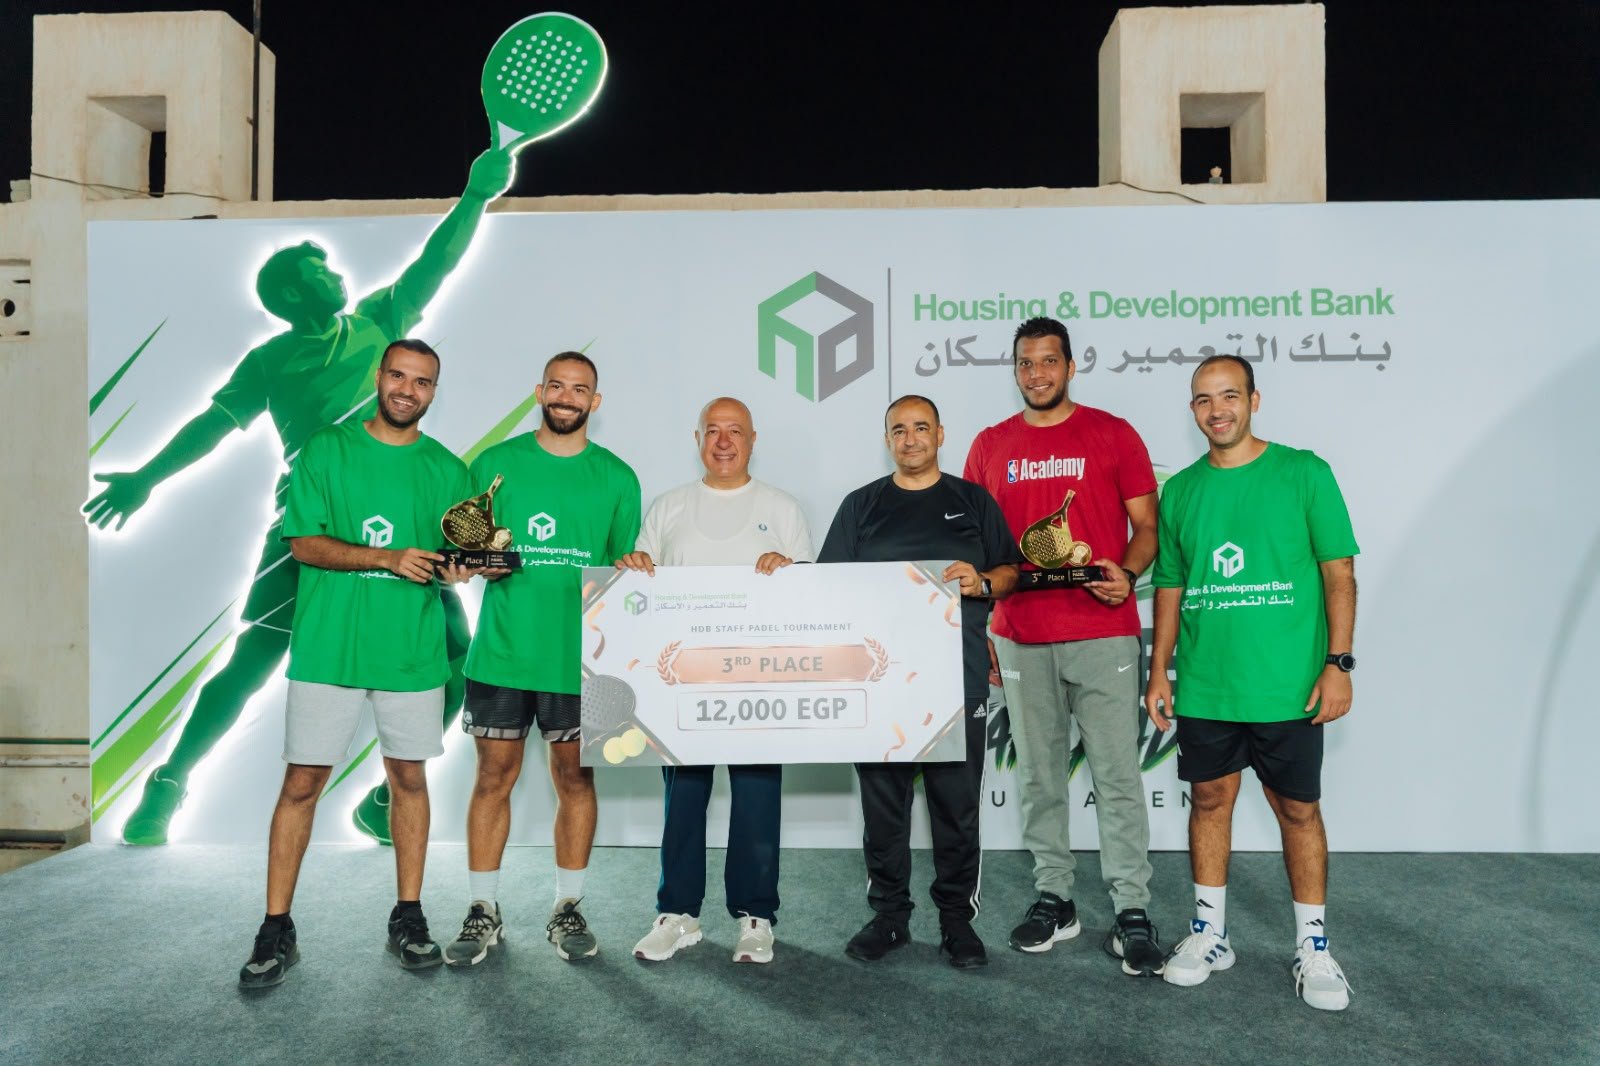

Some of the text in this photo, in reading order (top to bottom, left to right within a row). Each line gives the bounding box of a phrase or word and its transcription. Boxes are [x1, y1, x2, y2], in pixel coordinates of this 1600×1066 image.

[914, 287, 1395, 325] Housing & Development Bank
[1020, 455, 1086, 480] Academy
[465, 557, 483, 565] Place
[1202, 585, 1209, 594] &
[1210, 582, 1271, 594] Development
[691, 623, 852, 633] HDB STAFF PADEL TOURNAMENT
[722, 656, 823, 673] 3RD PLACE
[696, 697, 848, 725] 12,000 EGP
